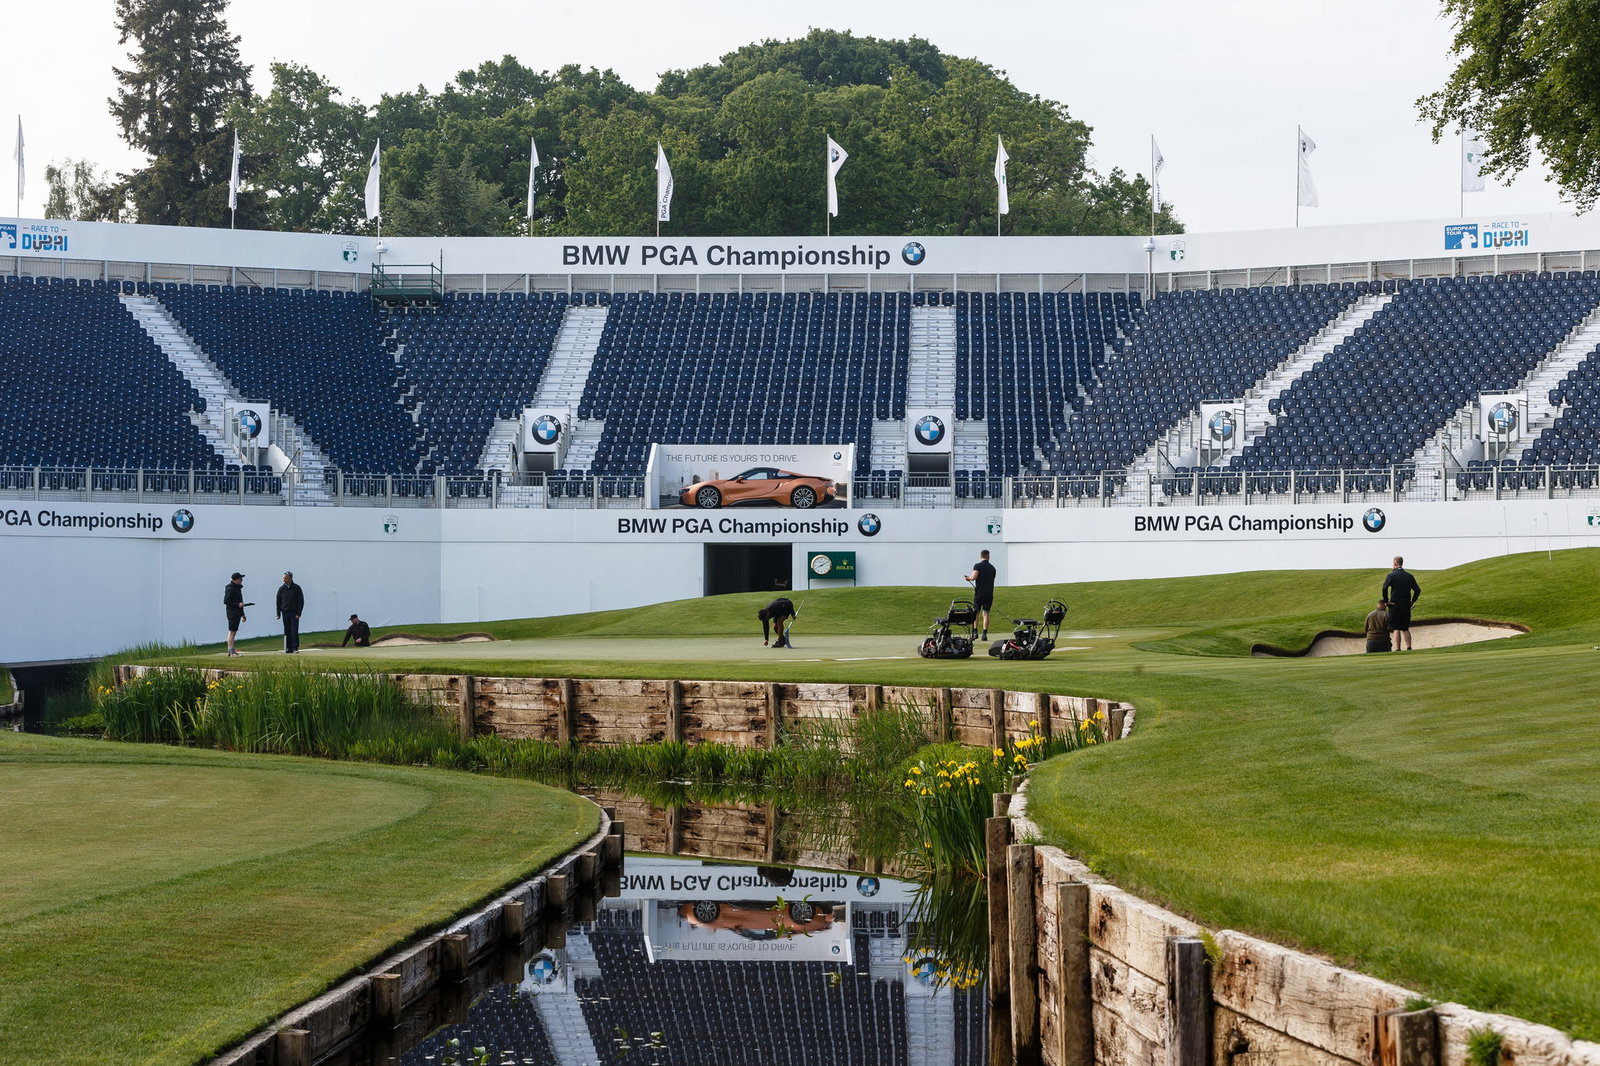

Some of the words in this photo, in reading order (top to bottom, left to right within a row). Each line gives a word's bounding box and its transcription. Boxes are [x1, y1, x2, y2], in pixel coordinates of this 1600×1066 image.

[22, 234, 68, 252] DUBAI
[1484, 230, 1528, 249] DUBAI
[563, 245, 630, 265] BMW
[642, 245, 698, 266] PGA
[707, 245, 890, 269] Championship
[666, 454, 682, 463] THE
[685, 454, 718, 463] FUTURE
[720, 454, 728, 463] IS
[729, 454, 757, 463] YOURS
[760, 454, 771, 463] TO
[773, 454, 799, 463] DRIVE.
[38, 510, 163, 532] Championship
[618, 519, 667, 533] BMW
[672, 518, 713, 533] PGA
[719, 518, 848, 537] Championship
[1135, 516, 1179, 531] BMW
[1185, 516, 1223, 531] PGA
[1229, 514, 1353, 534] Championship
